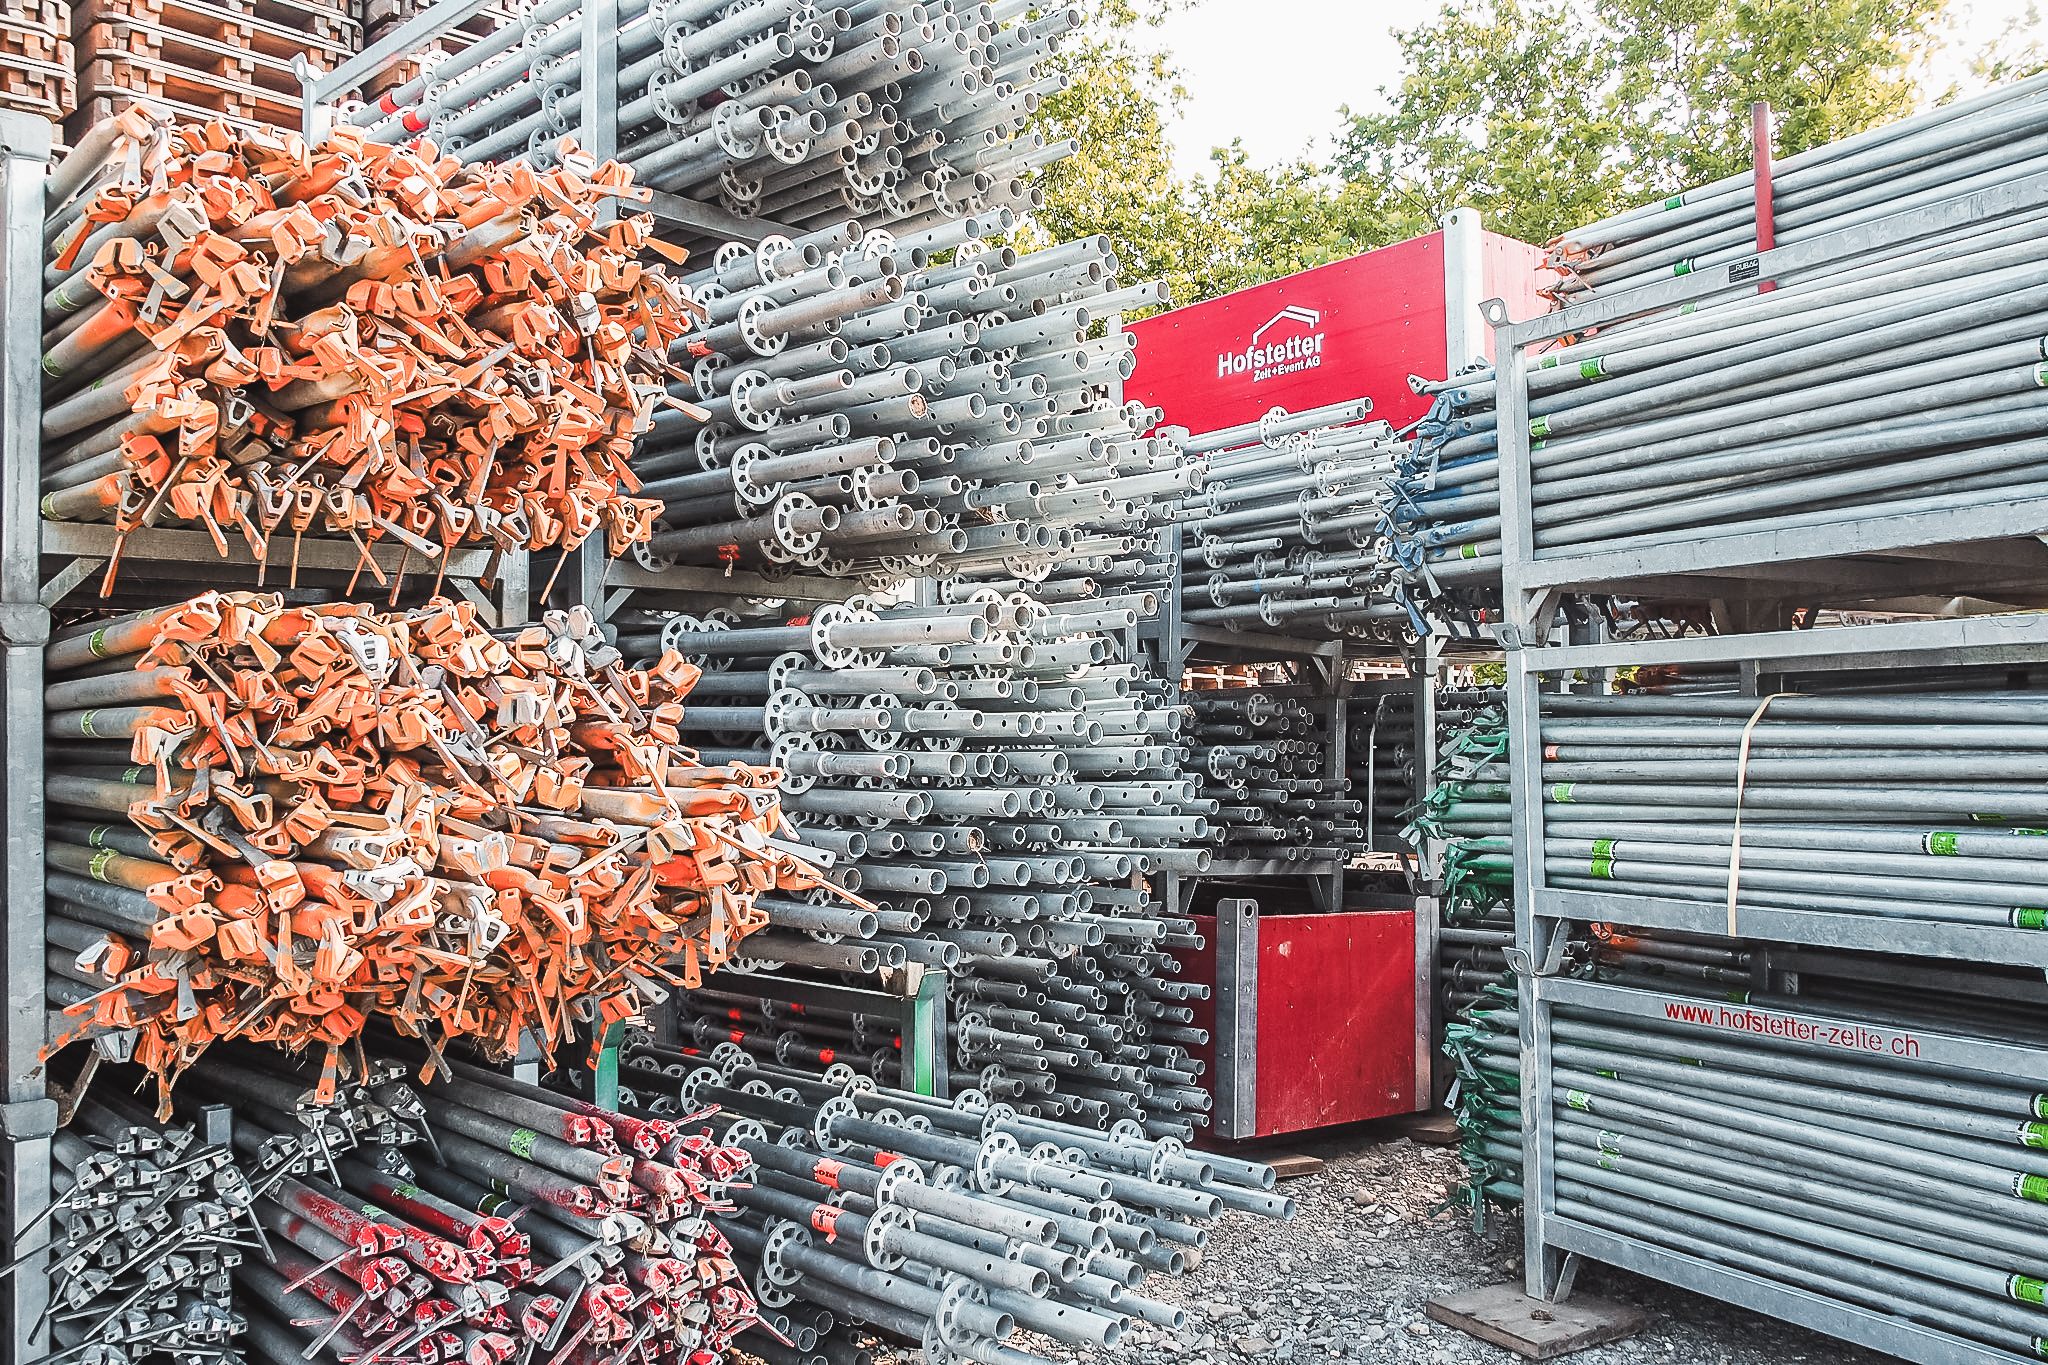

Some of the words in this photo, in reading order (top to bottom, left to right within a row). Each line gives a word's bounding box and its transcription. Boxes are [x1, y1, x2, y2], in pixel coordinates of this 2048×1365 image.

[1218, 333, 1325, 377] Hofstetter
[1305, 355, 1321, 369] AG
[1664, 1003, 1920, 1057] www.hofstetter-zelte.ch
